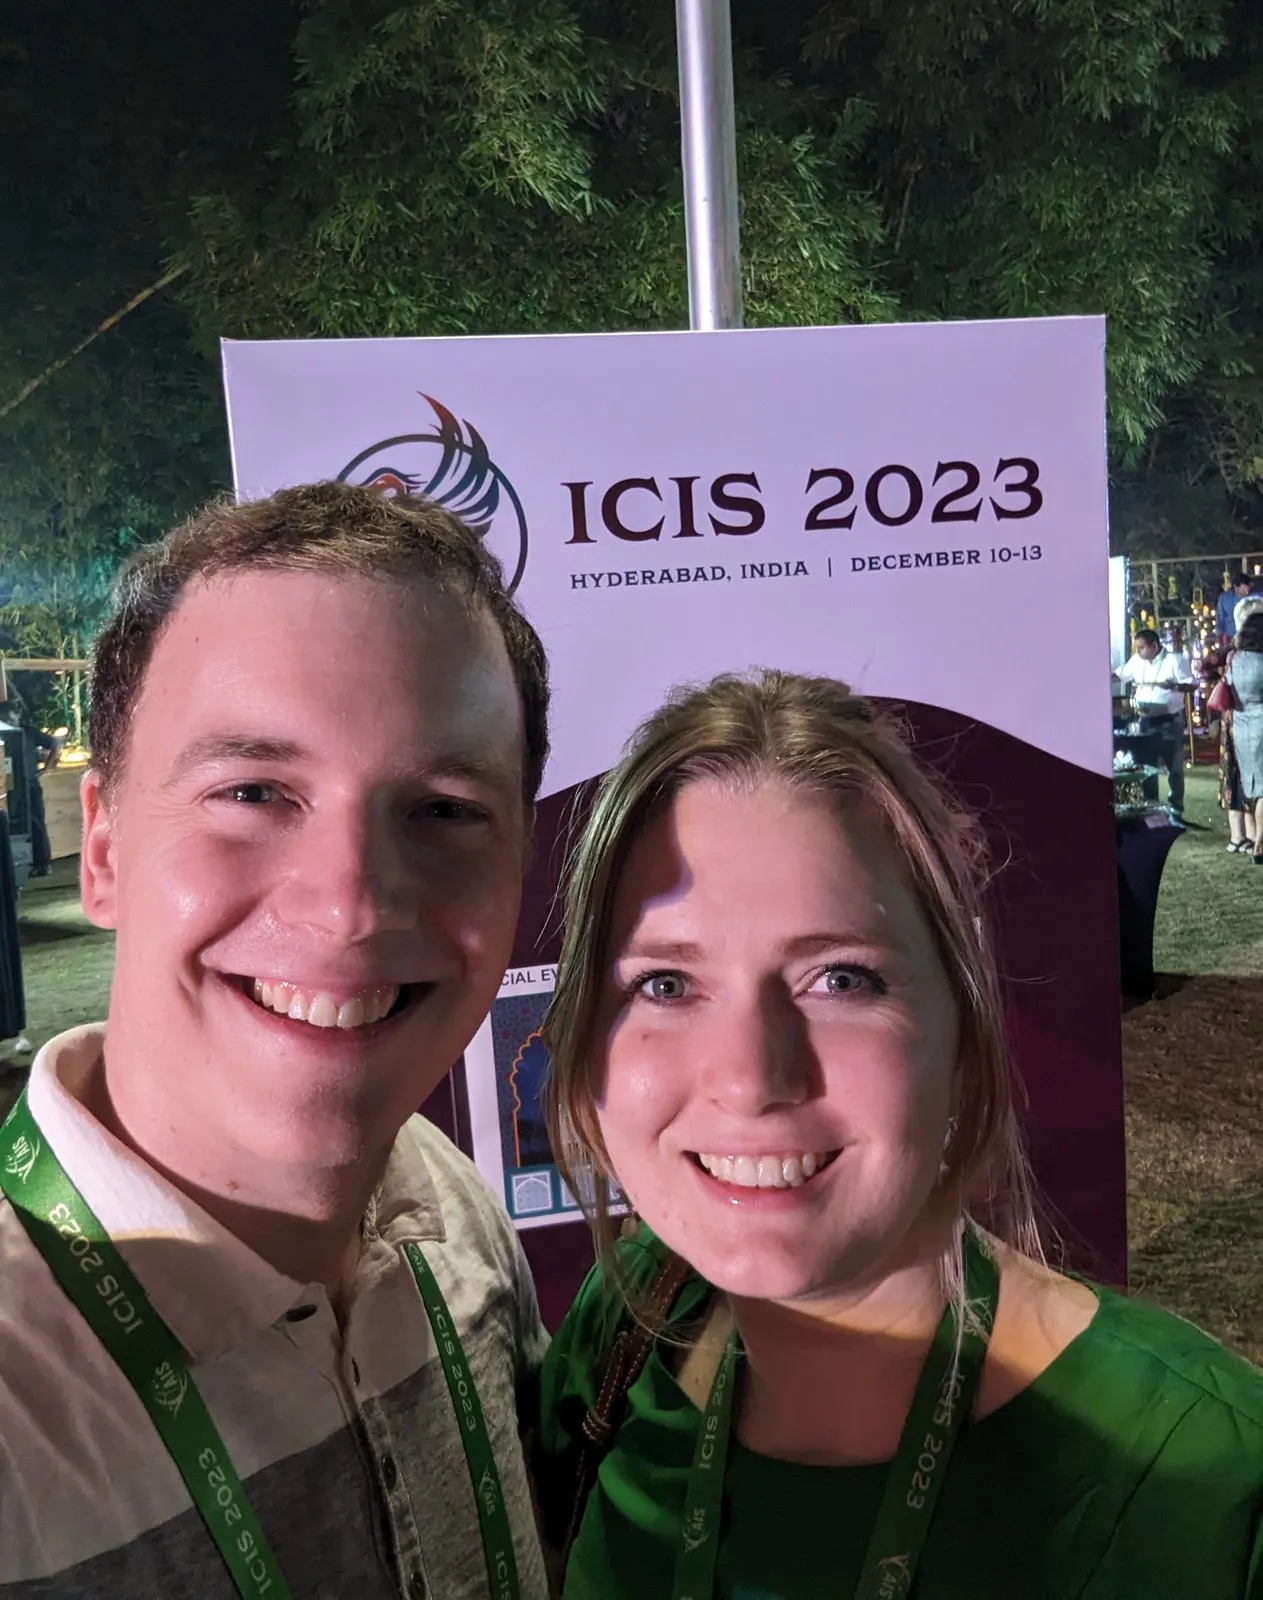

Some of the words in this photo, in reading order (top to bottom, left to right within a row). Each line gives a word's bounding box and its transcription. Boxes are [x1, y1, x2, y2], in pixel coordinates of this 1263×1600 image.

[560, 471, 766, 545] ICIS
[804, 457, 1044, 531] 2023
[570, 566, 731, 589] HYDERABAD,
[740, 561, 809, 579] INDIA
[850, 550, 981, 572] DECEMBER
[990, 545, 1042, 563] 10-13
[48, 1203, 103, 1273] 2023
[95, 1274, 144, 1334] ICIS
[432, 1305, 455, 1356] ICIS
[452, 1364, 477, 1431] 2023
[699, 1415, 718, 1469] ICIS
[906, 1433, 943, 1509] 2023
[199, 1447, 242, 1526] 2023
[236, 1530, 272, 1594] ICIS
